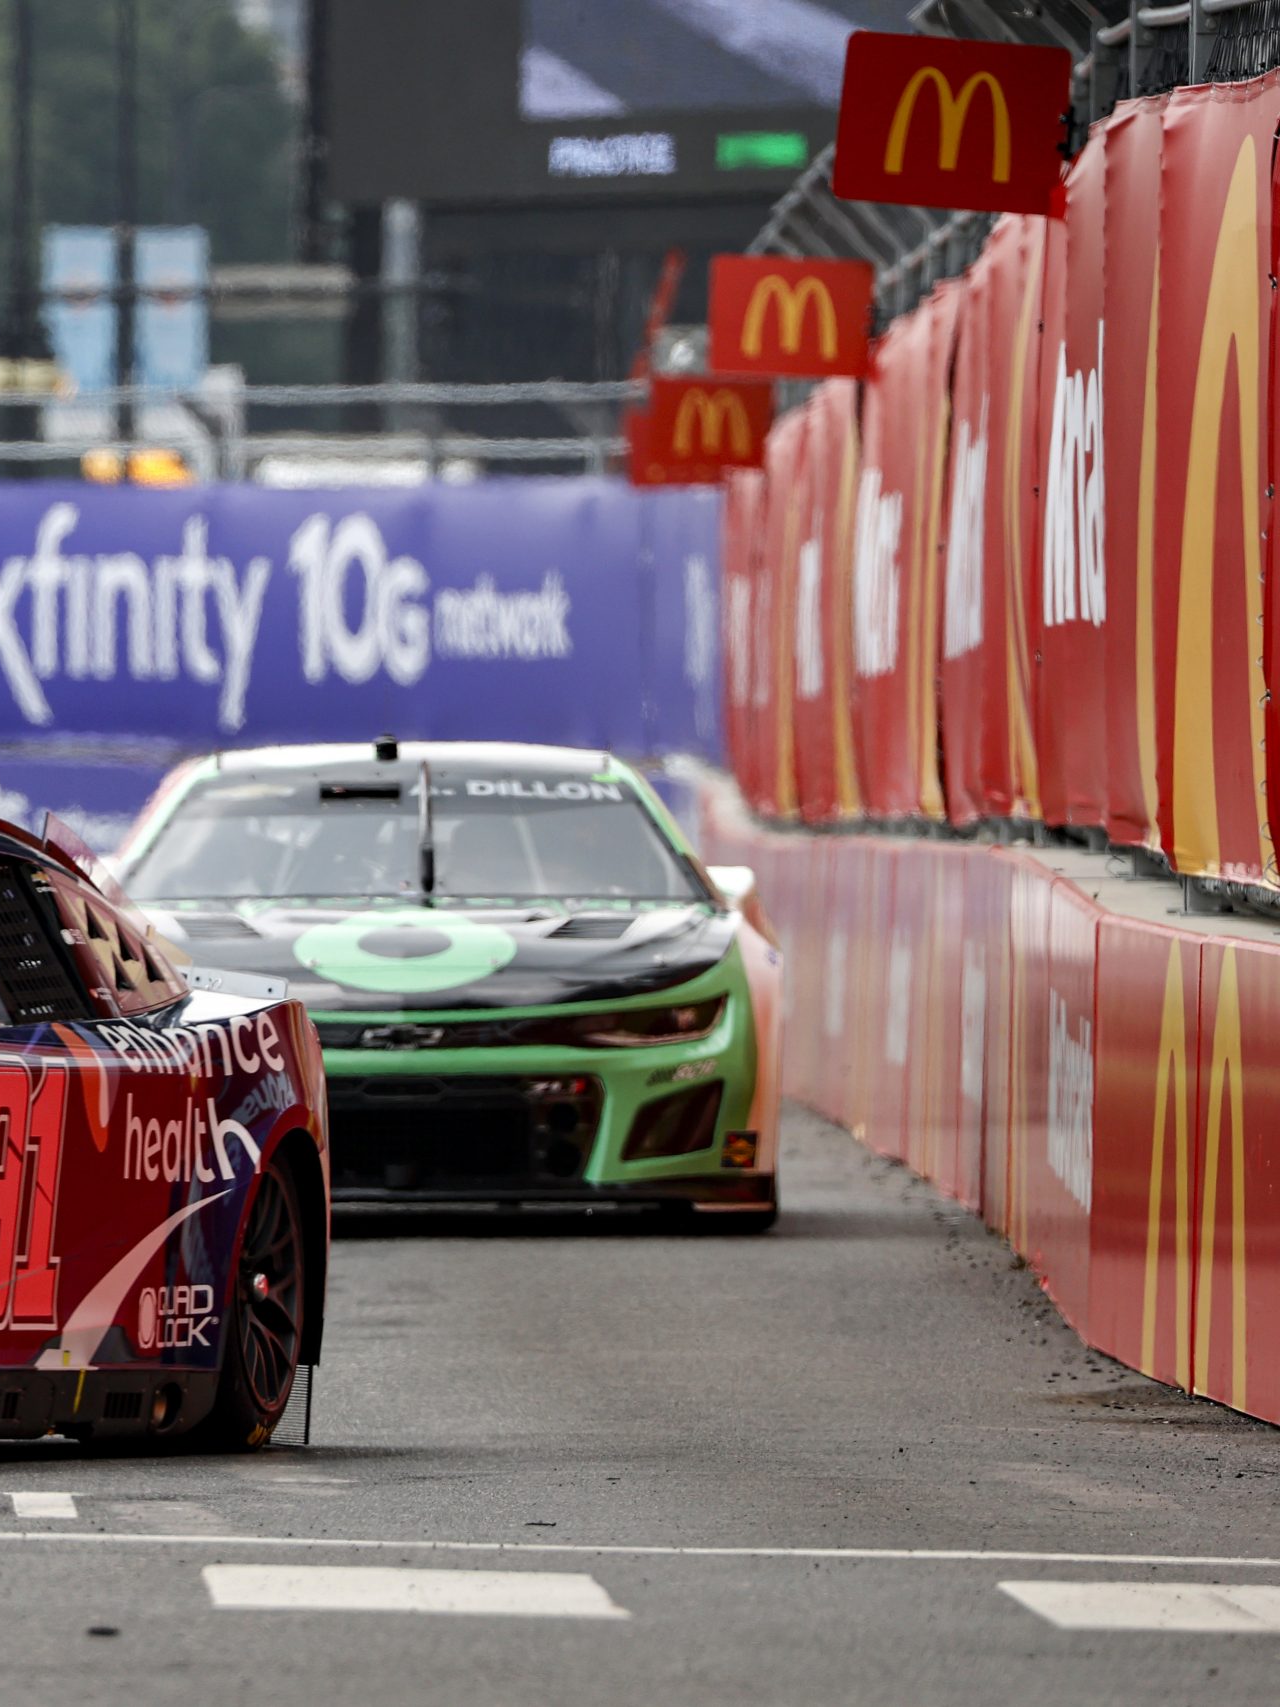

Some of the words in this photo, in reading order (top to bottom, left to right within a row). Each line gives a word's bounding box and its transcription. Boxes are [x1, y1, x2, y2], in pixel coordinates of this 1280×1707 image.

[465, 780, 623, 801] DILLON
[96, 1011, 285, 1079] enhance
[123, 1092, 262, 1184] health
[157, 1284, 214, 1316] QUAD
